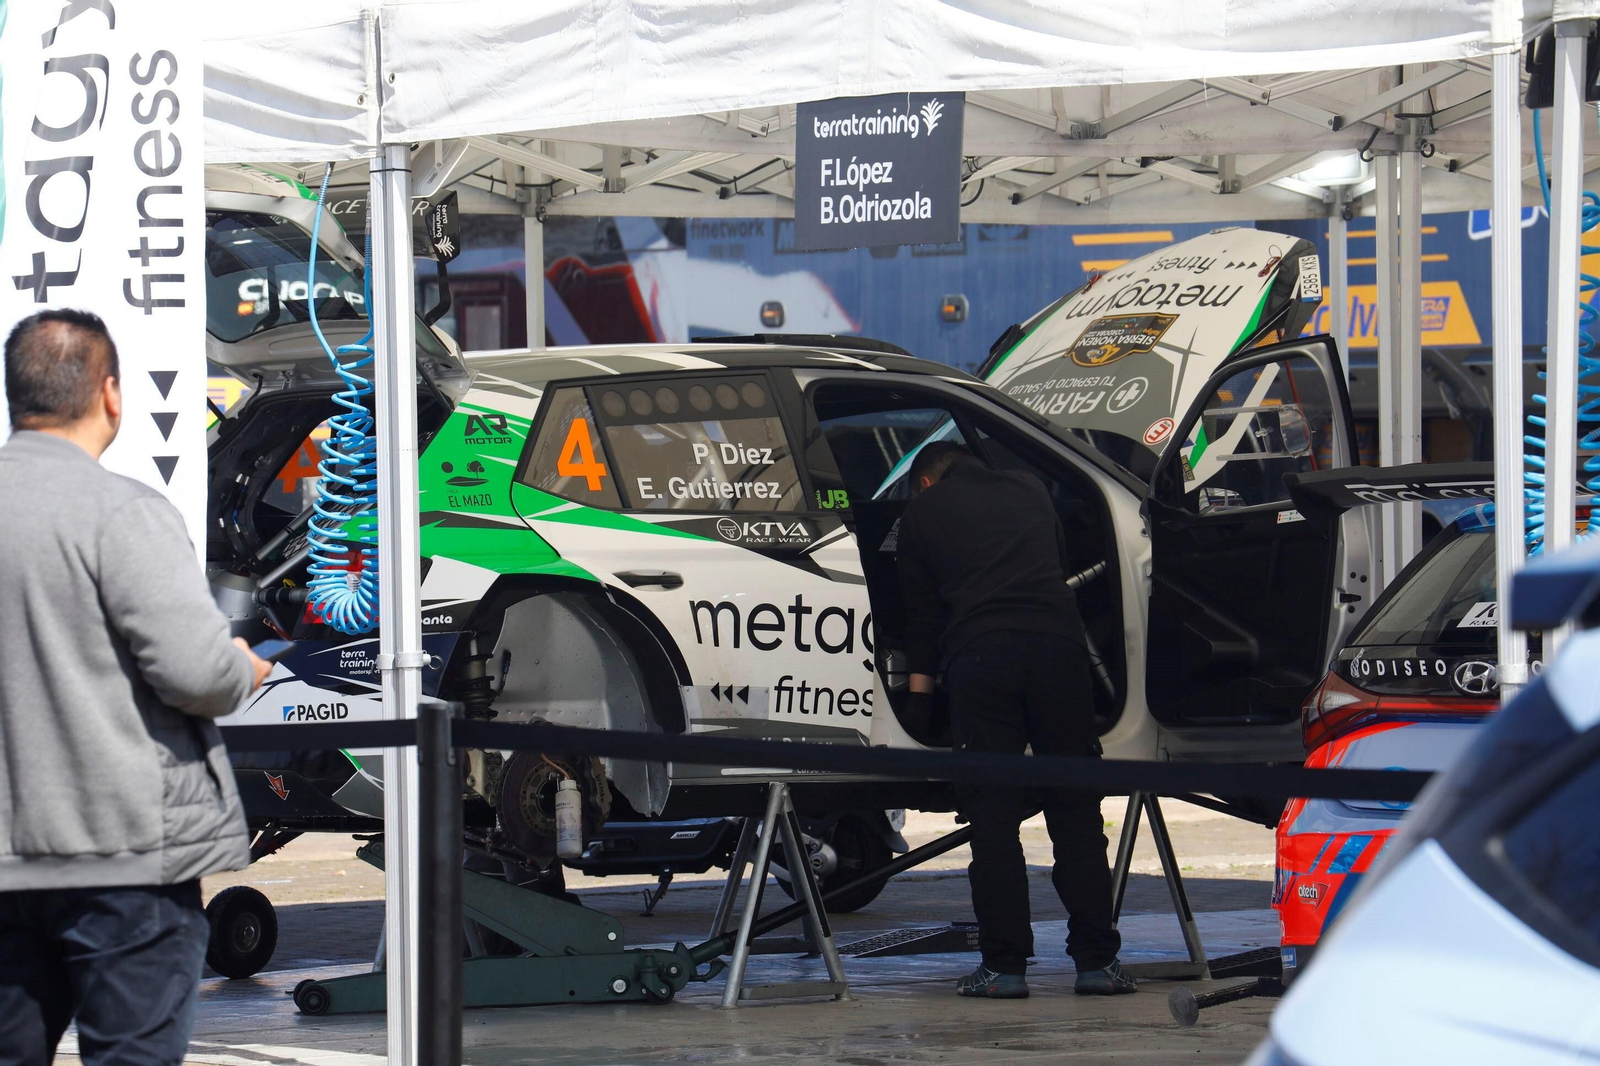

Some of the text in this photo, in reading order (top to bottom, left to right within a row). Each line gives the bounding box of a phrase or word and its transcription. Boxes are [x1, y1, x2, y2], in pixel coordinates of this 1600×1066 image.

[813, 107, 920, 138] terratraining
[122, 49, 186, 315] fitness
[820, 156, 893, 192] F.López
[820, 191, 932, 224] B.Odriozola
[1303, 273, 1319, 295] 2585
[1118, 334, 1157, 345] SIERRA
[1008, 382, 1043, 395] SALUD
[1055, 376, 1101, 388] ESPACIO
[1099, 375, 1117, 386] TU
[556, 417, 608, 492] 4
[692, 443, 775, 465] P. Diez
[636, 476, 783, 499] E. Gutierrez
[448, 493, 493, 508] EL MAZO
[743, 522, 809, 536] KTVA
[419, 614, 453, 626] anta
[339, 657, 378, 668] trainin
[341, 650, 366, 659] terra
[297, 702, 349, 721] PAGID
